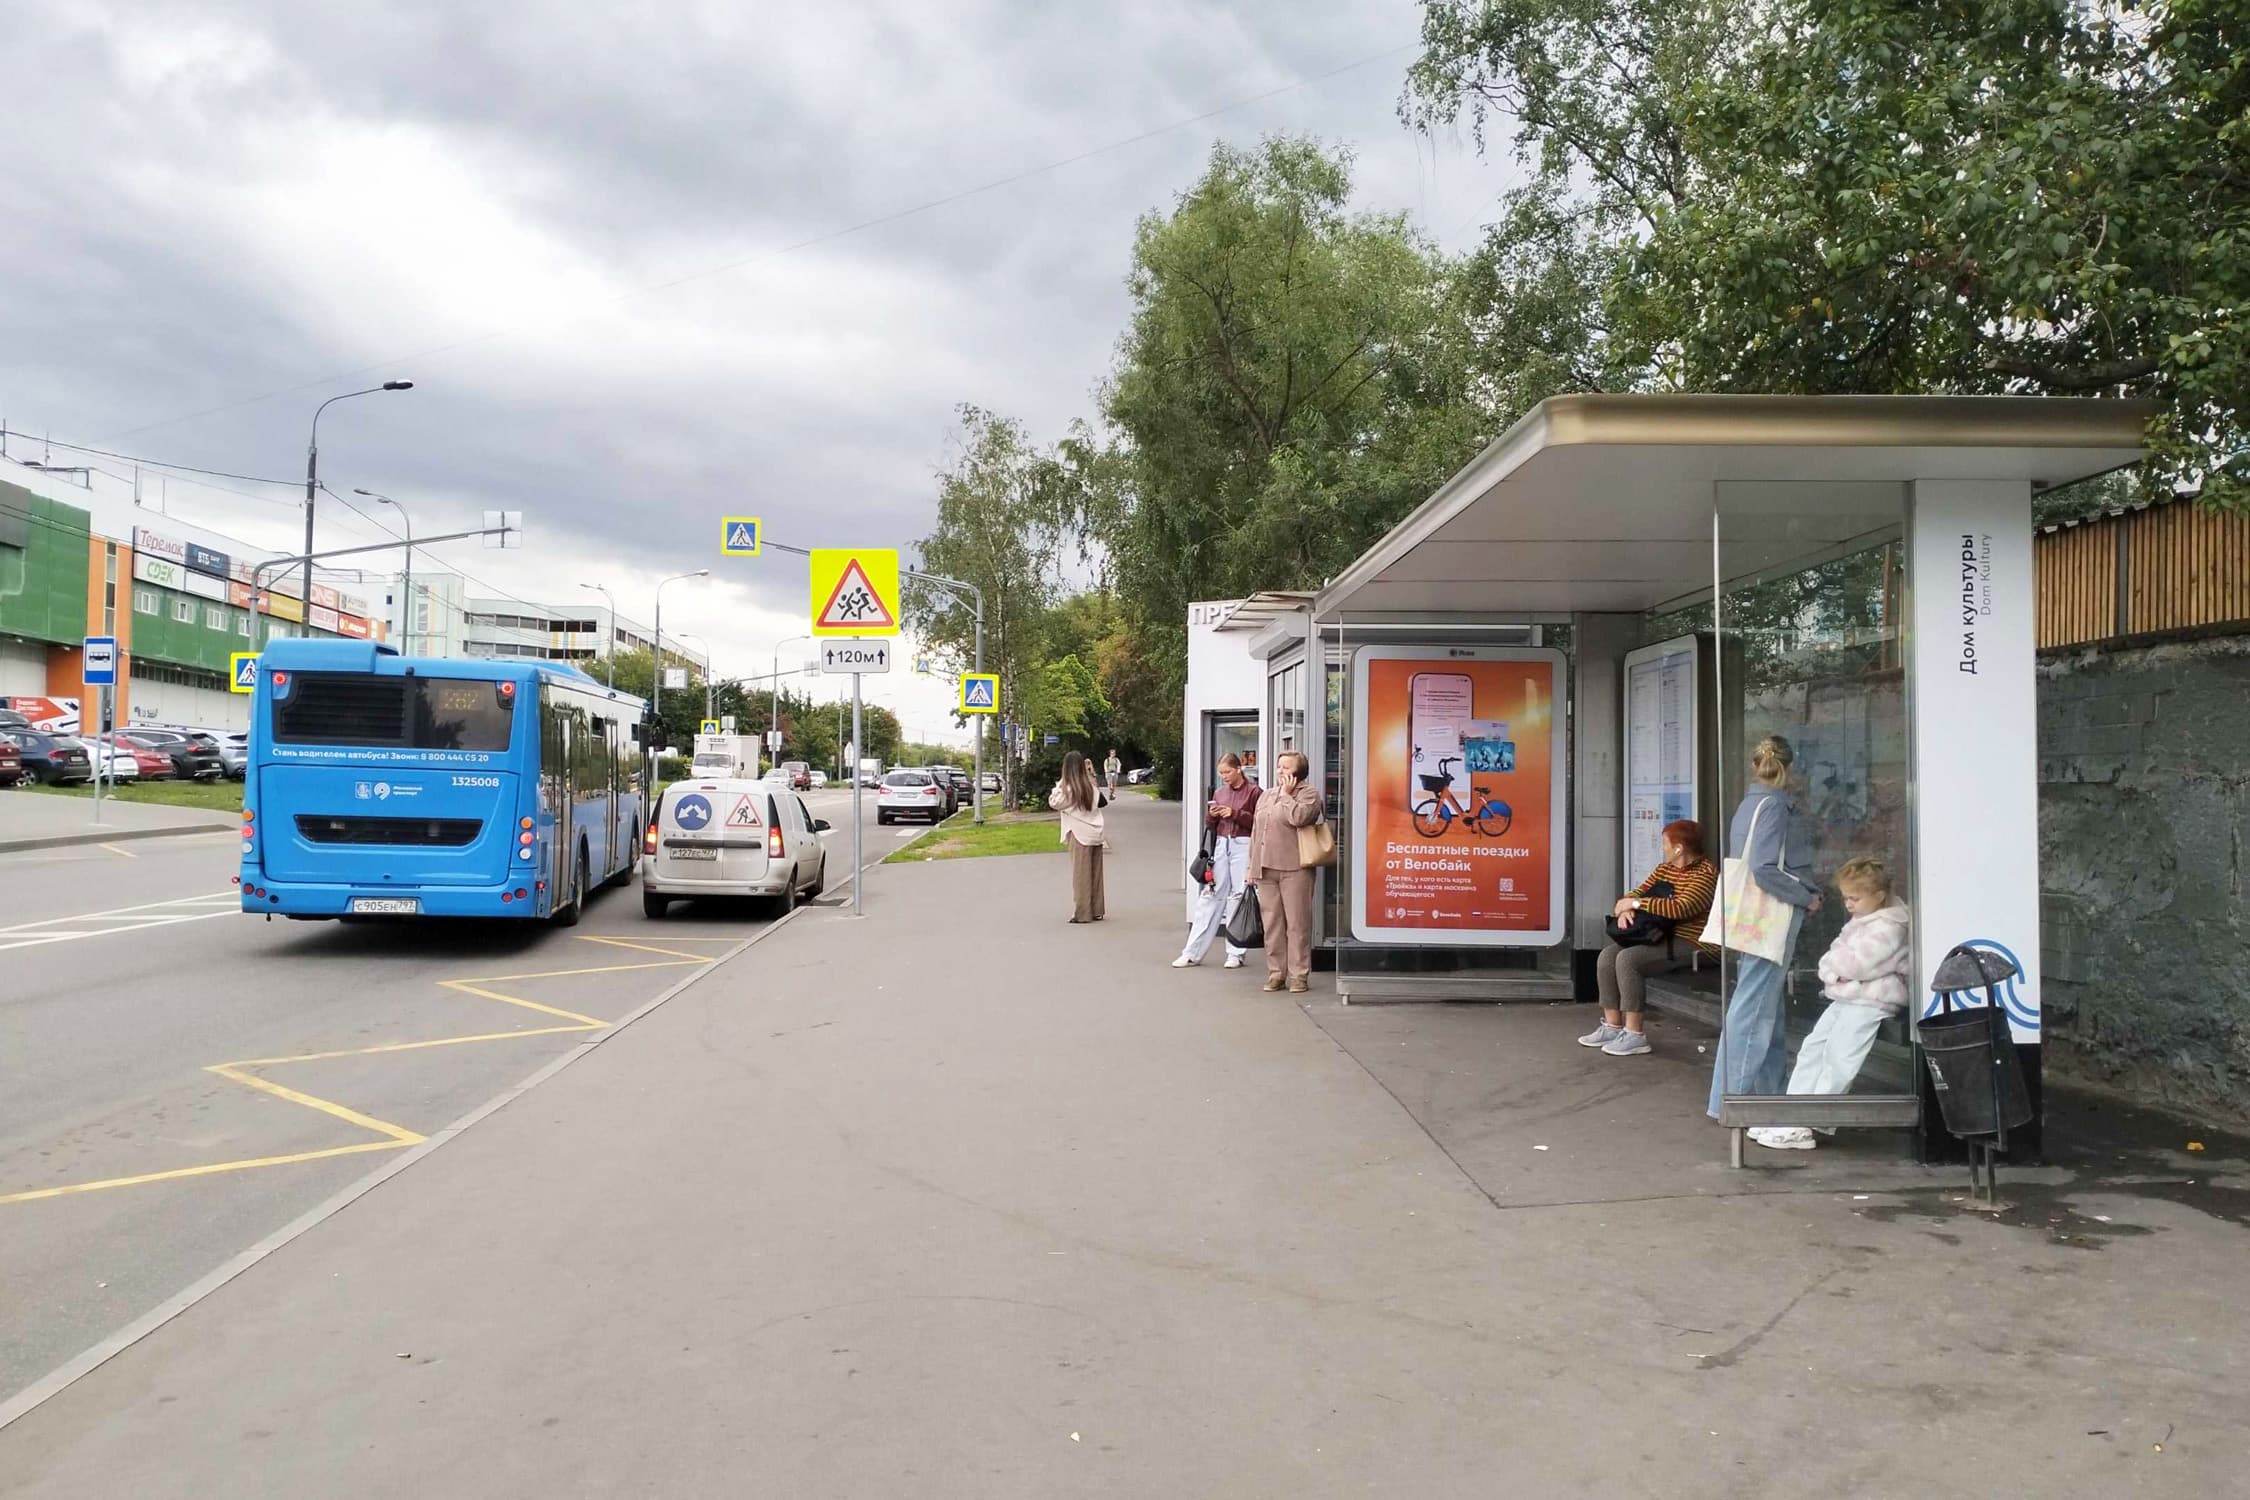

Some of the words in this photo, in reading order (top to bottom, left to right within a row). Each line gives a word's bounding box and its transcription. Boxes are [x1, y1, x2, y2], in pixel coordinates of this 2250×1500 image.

[141, 530, 183, 558] Теремок
[1980, 534, 1993, 581] Kultury
[1962, 535, 1978, 625] культуры
[1980, 585, 1991, 616] Dom
[1960, 631, 1978, 674] Дом
[452, 776, 500, 787] 1325008
[1386, 842, 1470, 856] Бесплатные
[1472, 846, 1529, 858] поездки
[1386, 861, 1400, 869] от
[1404, 858, 1471, 871] Велобайк
